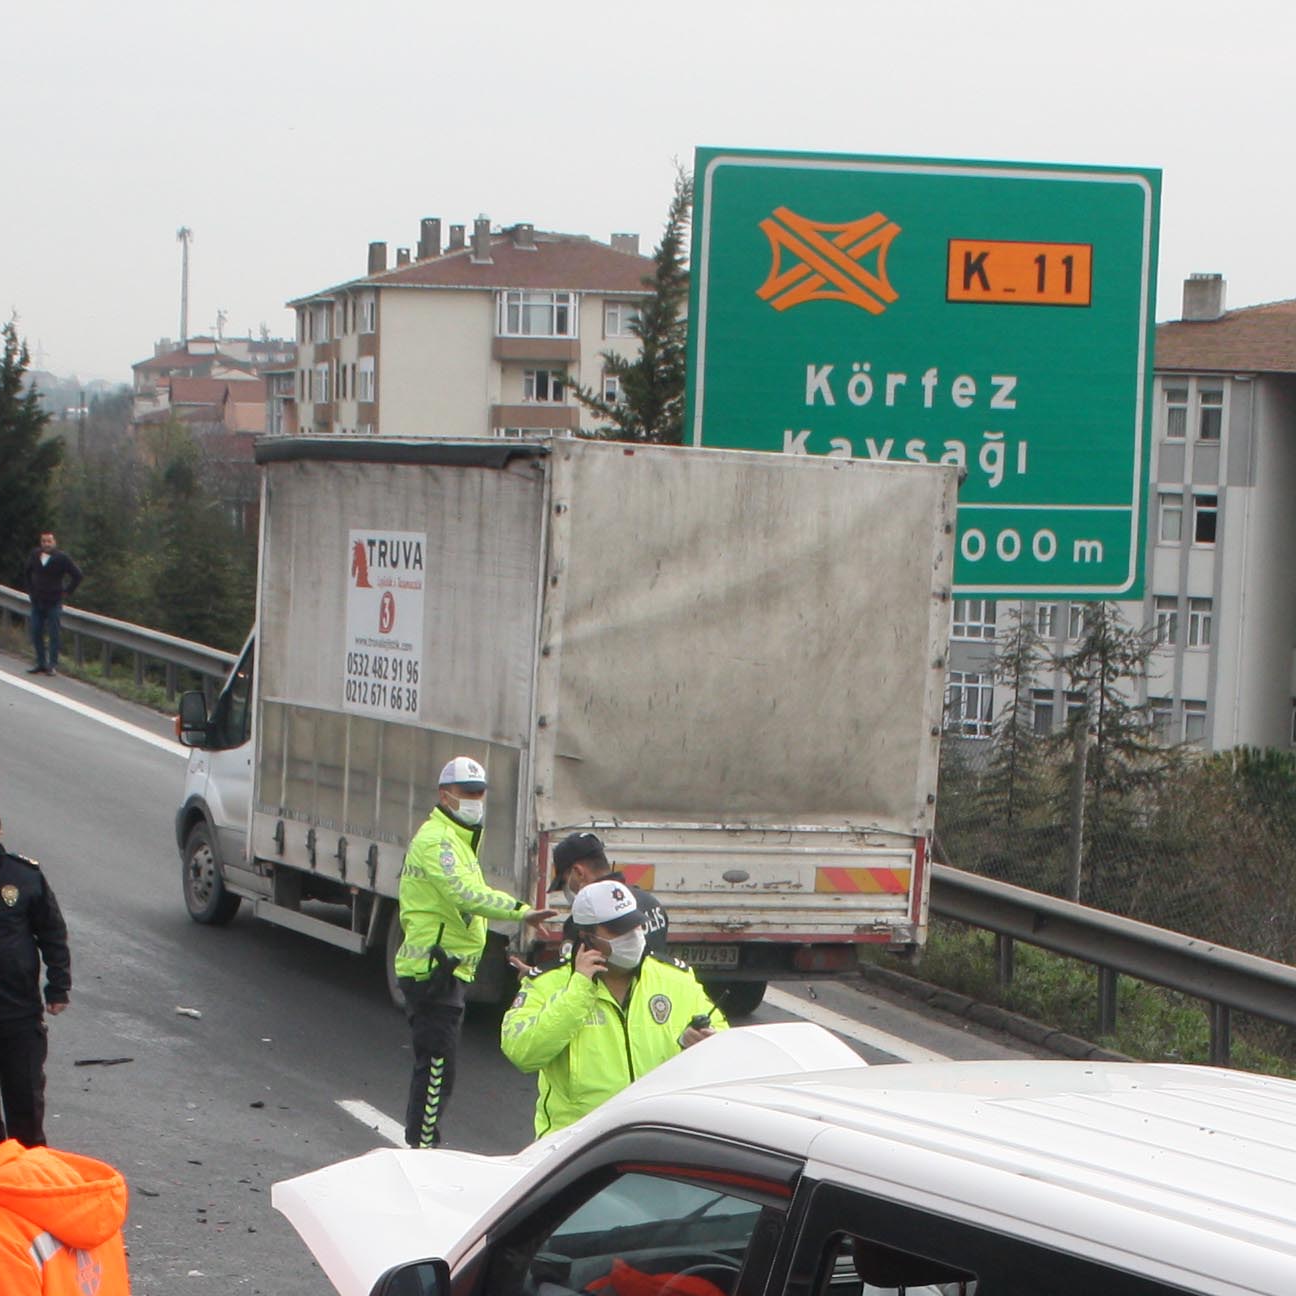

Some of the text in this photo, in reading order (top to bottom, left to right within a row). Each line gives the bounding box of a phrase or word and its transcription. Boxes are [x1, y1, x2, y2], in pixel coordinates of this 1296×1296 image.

[805, 362, 1017, 410] Körfez
[367, 539, 423, 571] TRUVA
[1073, 539, 1103, 563] m
[347, 652, 419, 684] 0532 482 91 96
[346, 679, 418, 713] 0212 671 66 38
